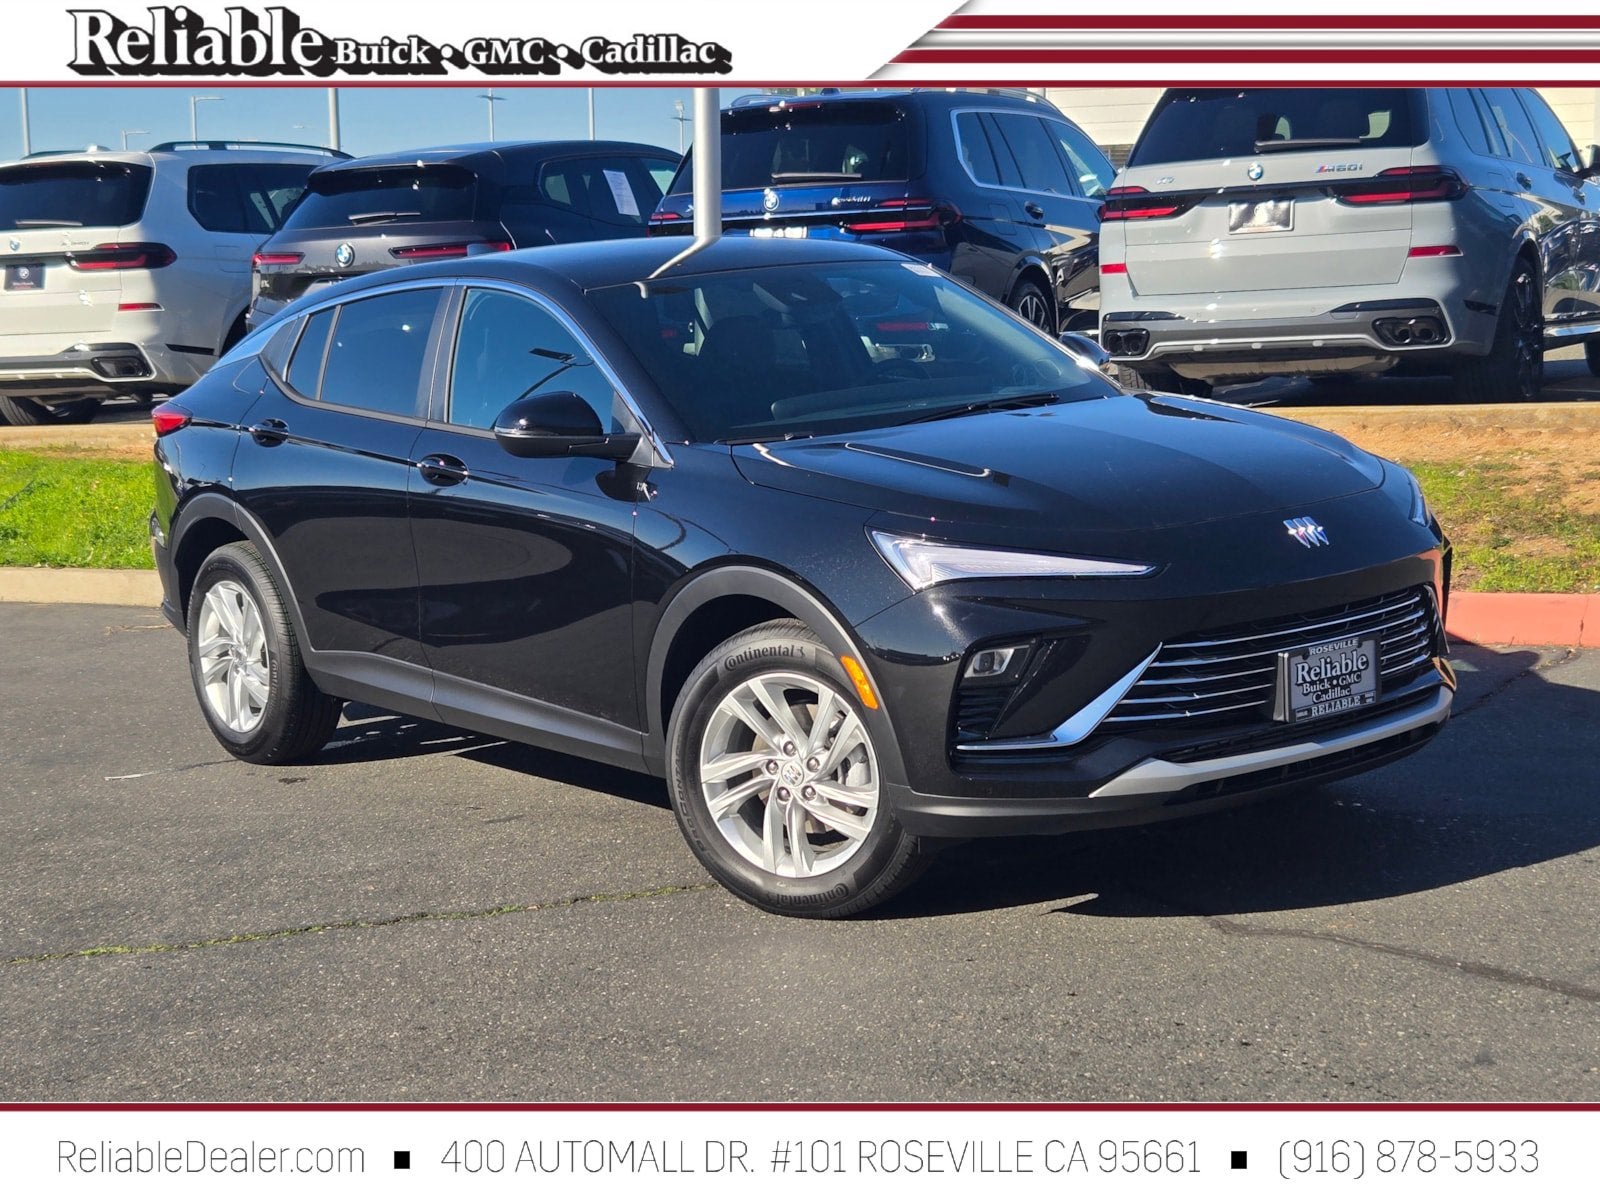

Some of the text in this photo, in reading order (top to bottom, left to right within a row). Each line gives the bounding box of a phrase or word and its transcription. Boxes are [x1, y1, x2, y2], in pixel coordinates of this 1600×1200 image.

[1309, 637, 1360, 655] ROSEVILLE
[724, 645, 795, 671] Continental
[1296, 649, 1369, 686] Reliable
[1302, 672, 1361, 695] Buick GMC
[1311, 696, 1360, 717] RELIABLE
[1312, 687, 1351, 704] Cadillac
[776, 883, 850, 905] Continental
